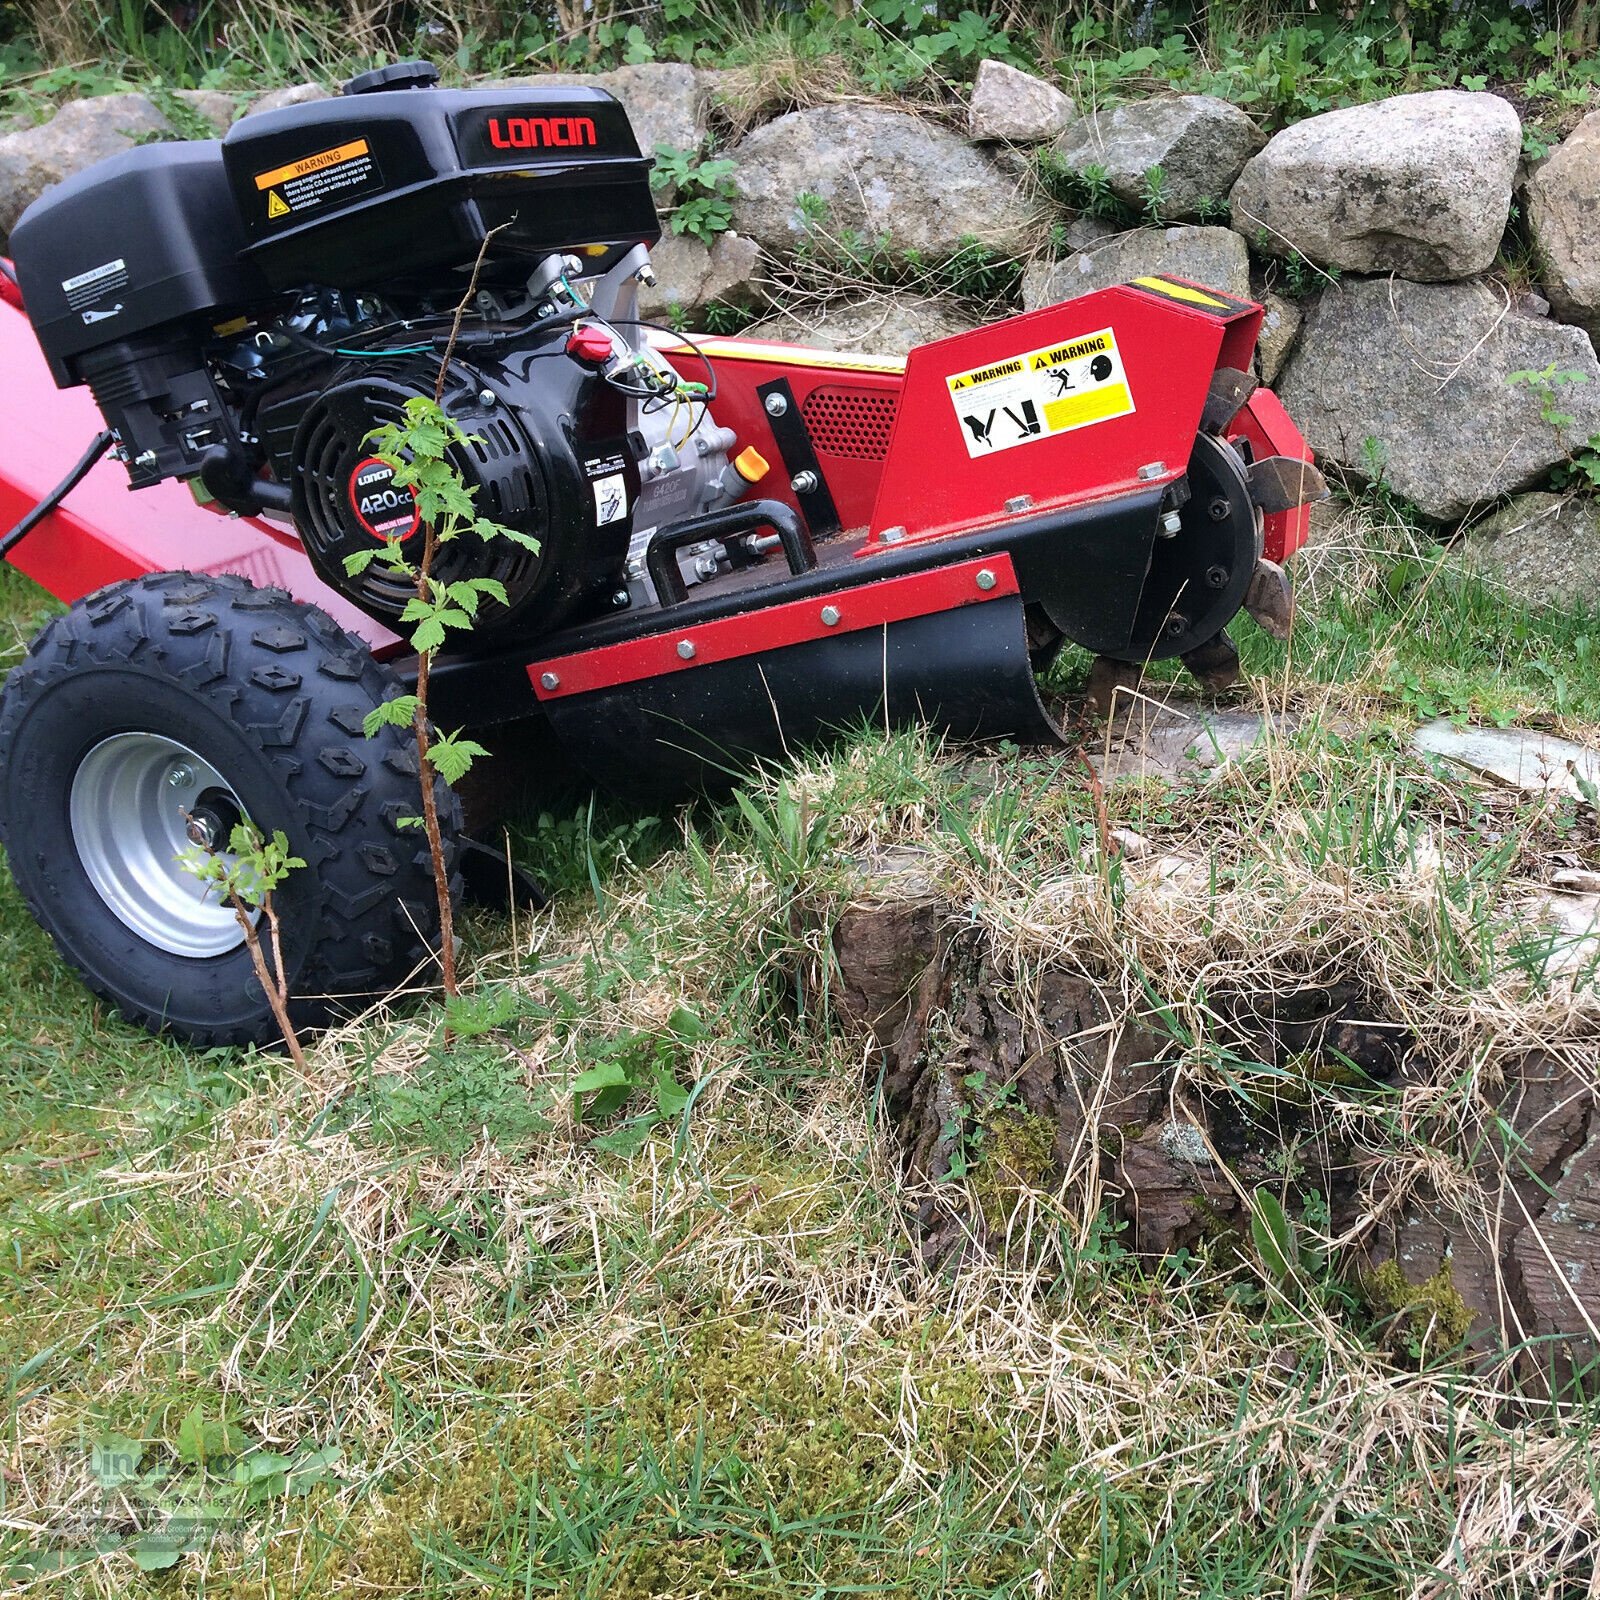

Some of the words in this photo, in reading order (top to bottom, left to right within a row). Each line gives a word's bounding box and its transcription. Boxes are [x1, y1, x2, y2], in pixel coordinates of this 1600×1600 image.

[488, 117, 597, 148] LONCIN
[295, 151, 342, 173] WARNING
[329, 179, 352, 190] without
[1050, 338, 1105, 364] WARNING
[971, 361, 1021, 384] WARNING
[358, 468, 392, 486] LONCIN
[360, 490, 413, 514] 420cc
